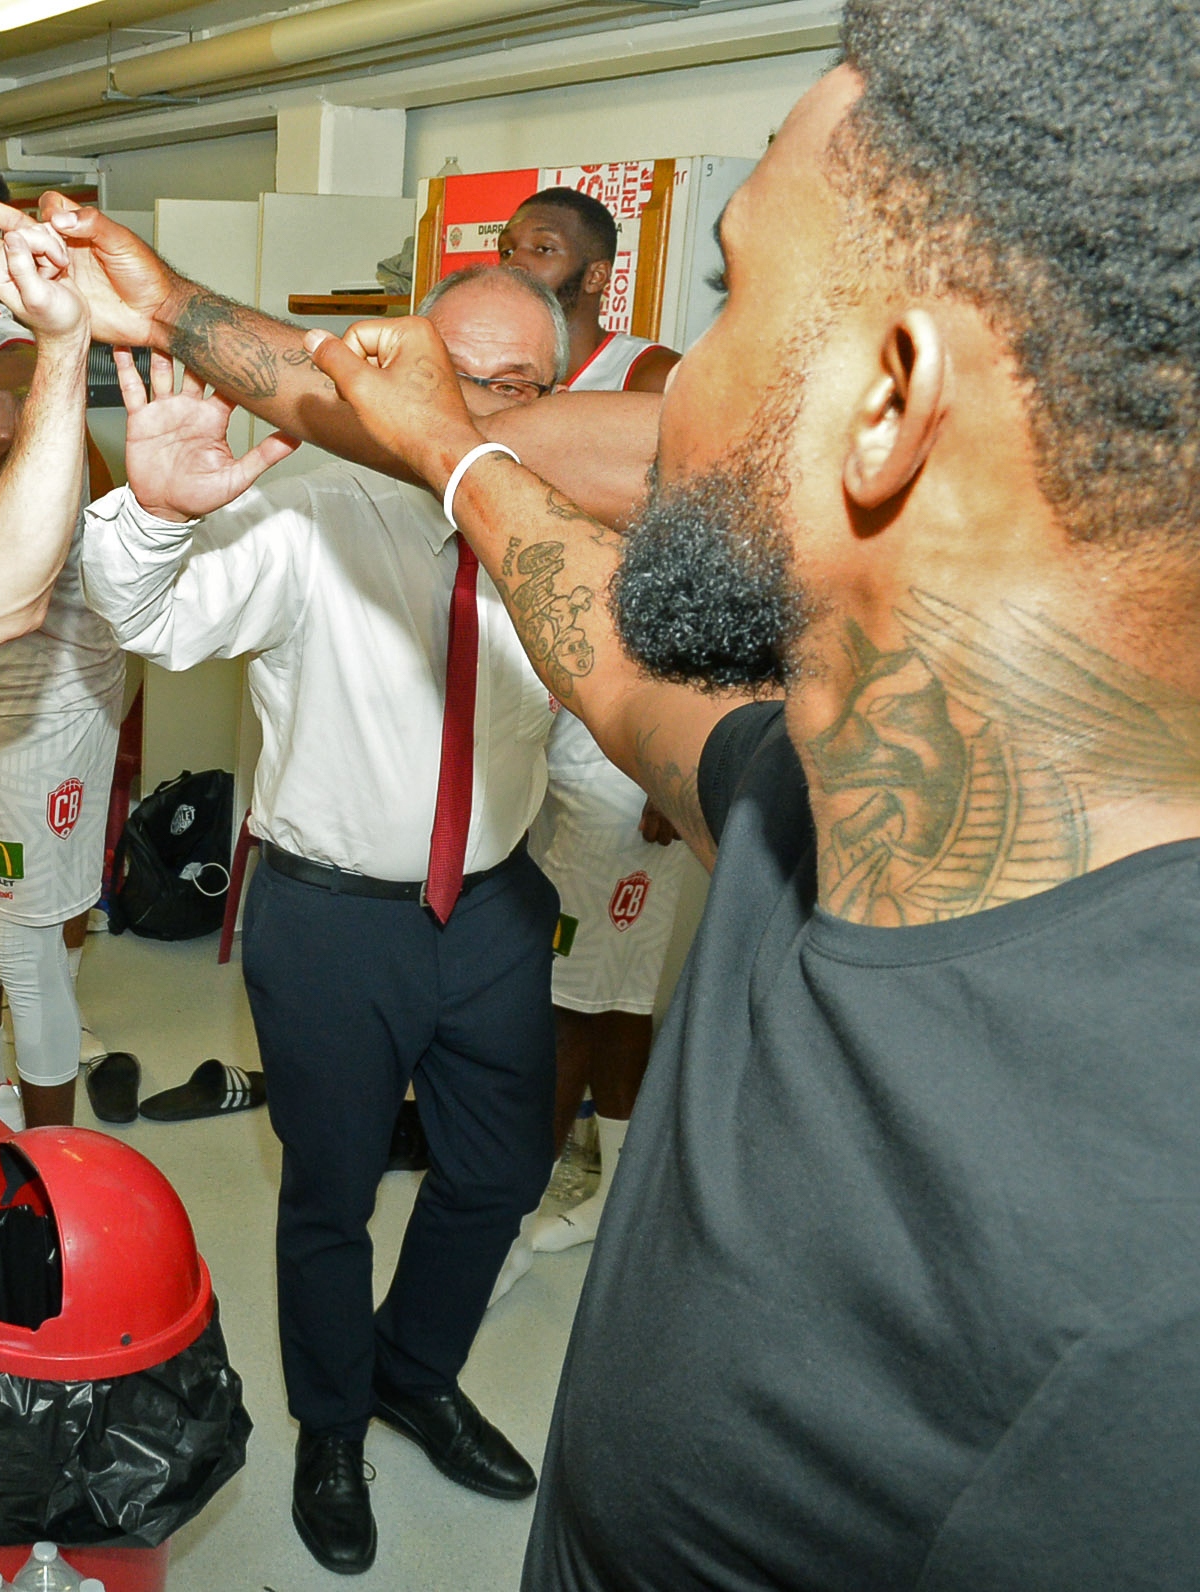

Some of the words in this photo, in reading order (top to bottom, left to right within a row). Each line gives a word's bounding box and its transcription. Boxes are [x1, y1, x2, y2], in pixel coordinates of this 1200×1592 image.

[478, 223, 504, 235] DIARR
[54, 790, 80, 828] CB
[613, 884, 645, 917] CB
